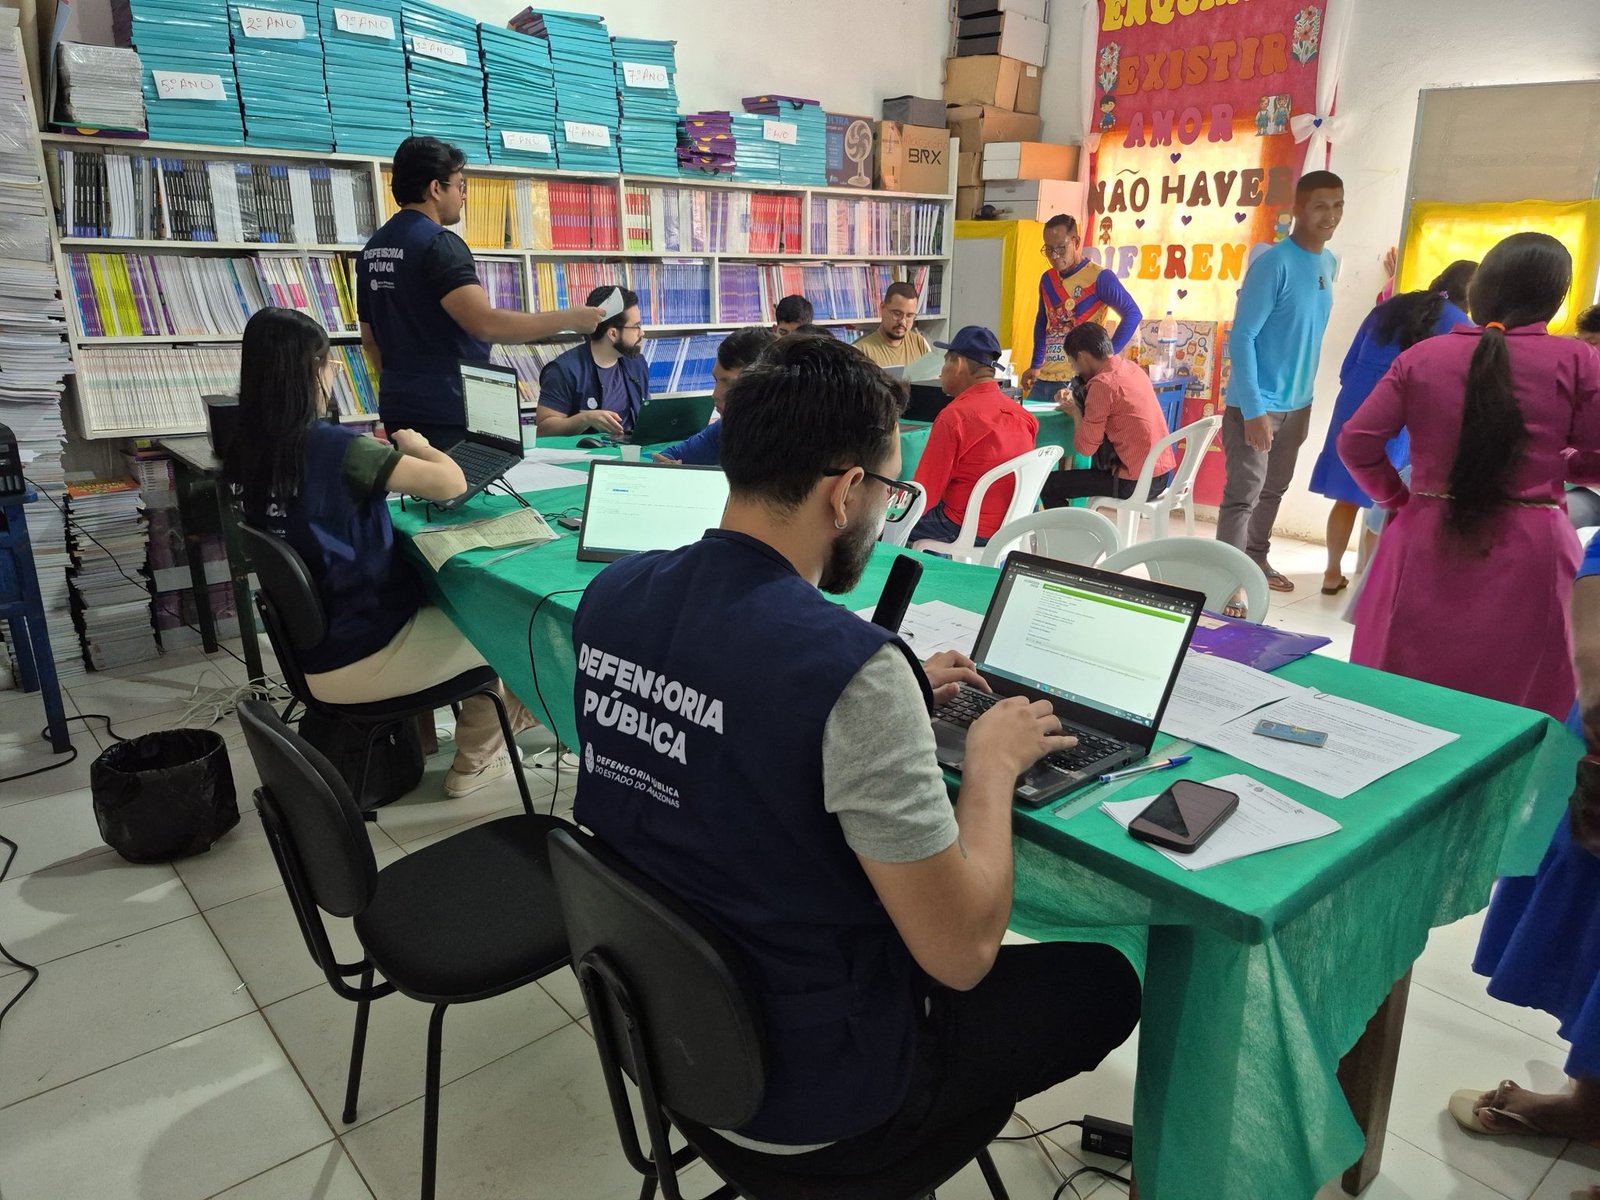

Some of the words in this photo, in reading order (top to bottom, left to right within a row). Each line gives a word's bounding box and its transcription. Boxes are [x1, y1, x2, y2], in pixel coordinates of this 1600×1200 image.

[266, 17, 297, 31] ANO
[359, 19, 389, 30] ANO
[642, 70, 665, 81] ANO
[1115, 32, 1288, 95] EXISTIR
[180, 78, 214, 90] ANO
[582, 129, 604, 138] ANO
[1123, 103, 1234, 148] AMOR
[908, 148, 942, 165] BRX
[1087, 168, 1150, 214] NÃO
[578, 642, 724, 735] DEFENSORIA
[583, 688, 687, 765] PÚBLICA
[595, 765, 604, 778] DO
[603, 769, 633, 786] ESTADO
[634, 780, 647, 791] DO
[596, 755, 650, 783] DEFENSORIA
